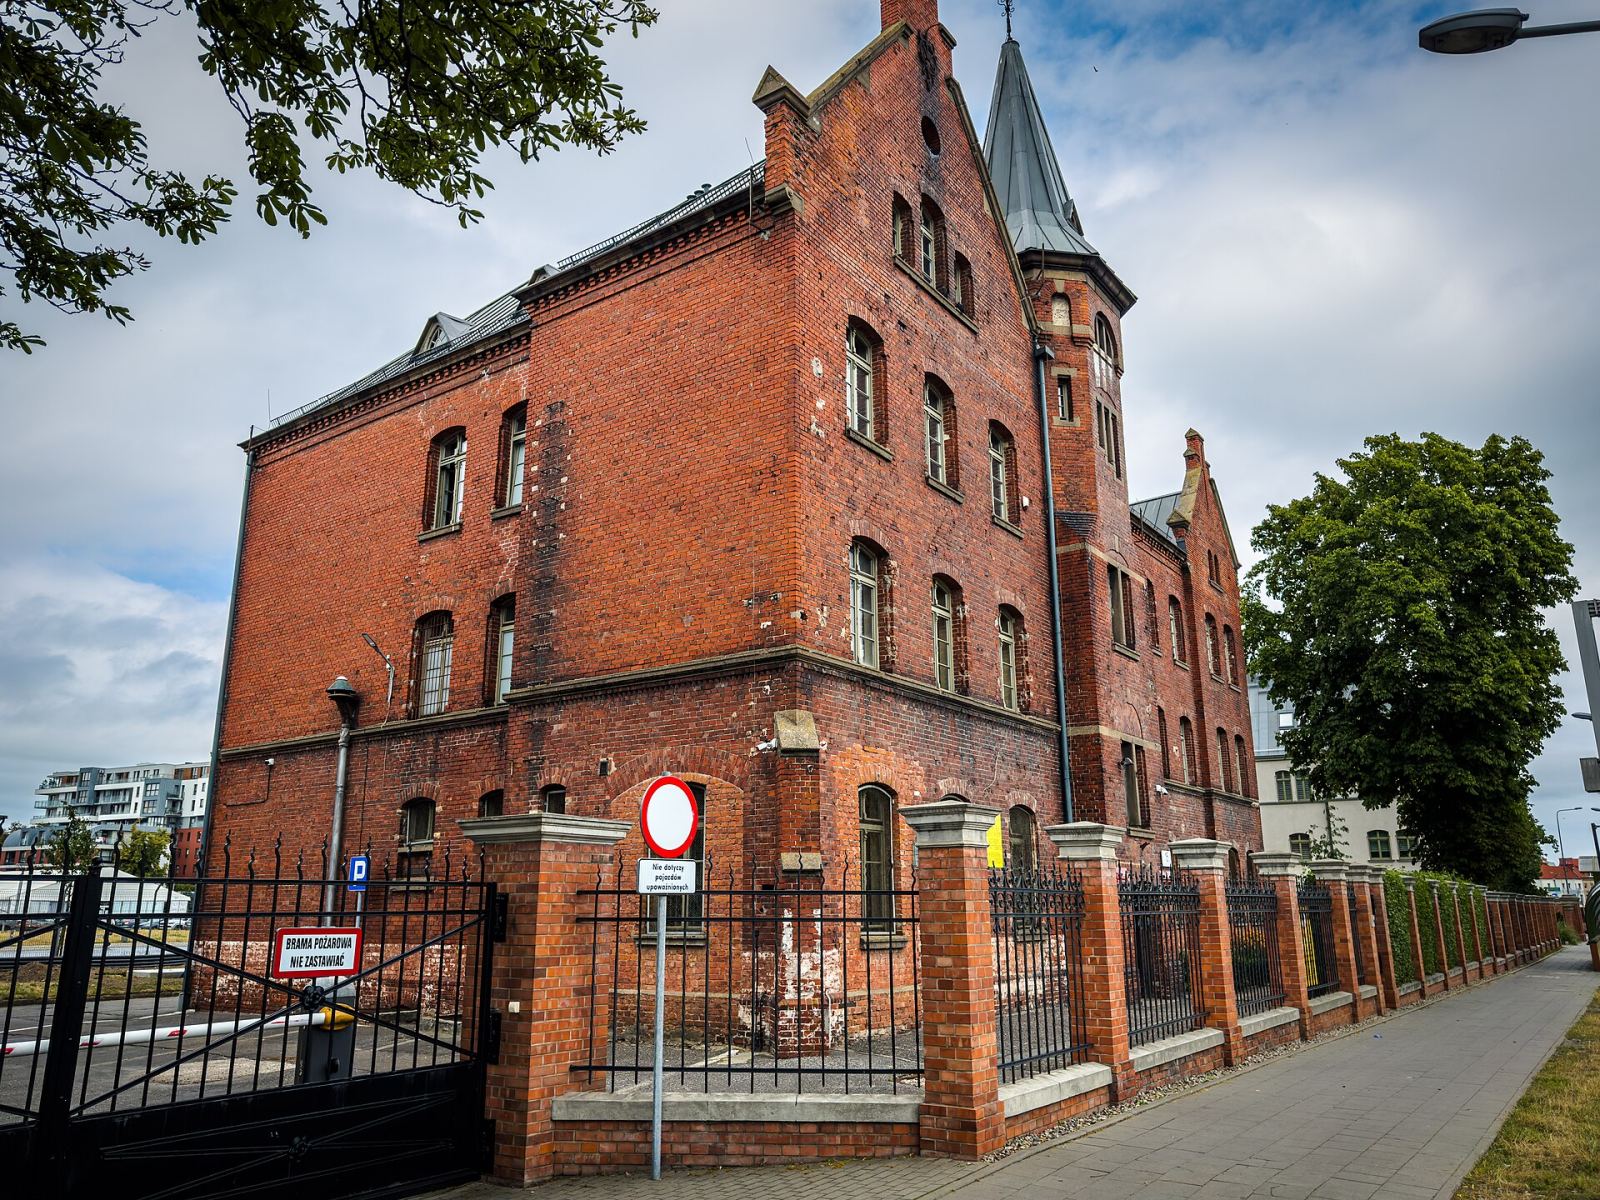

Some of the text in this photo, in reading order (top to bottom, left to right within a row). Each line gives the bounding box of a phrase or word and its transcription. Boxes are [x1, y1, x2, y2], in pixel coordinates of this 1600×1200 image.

[353, 860, 366, 886] P
[652, 863, 684, 872] Nie dotyczy
[655, 873, 682, 882] pojazdów
[646, 883, 689, 892] upoważnionych
[286, 935, 352, 950] BRAMA POŻAROWA
[290, 952, 345, 968] NIE ZASTAWIAĆ
